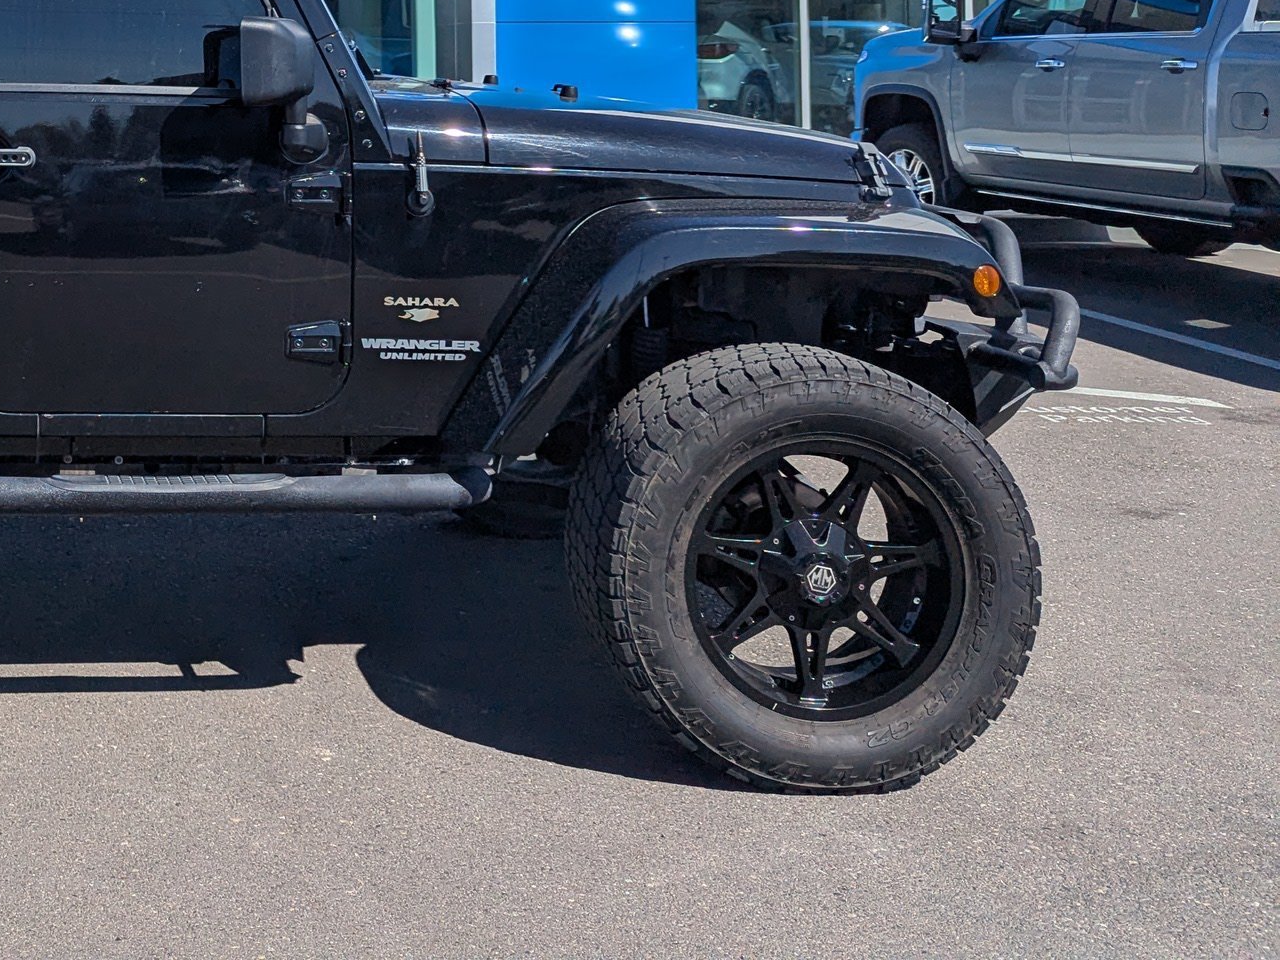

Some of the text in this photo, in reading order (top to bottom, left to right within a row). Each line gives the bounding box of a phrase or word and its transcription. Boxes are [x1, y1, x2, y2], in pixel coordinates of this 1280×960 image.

[383, 296, 460, 307] SAHARA
[360, 338, 481, 352] WRANGLER
[379, 351, 467, 361] UNLIMITED
[1020, 405, 1193, 414] ustomer
[1038, 414, 1212, 426] Parking
